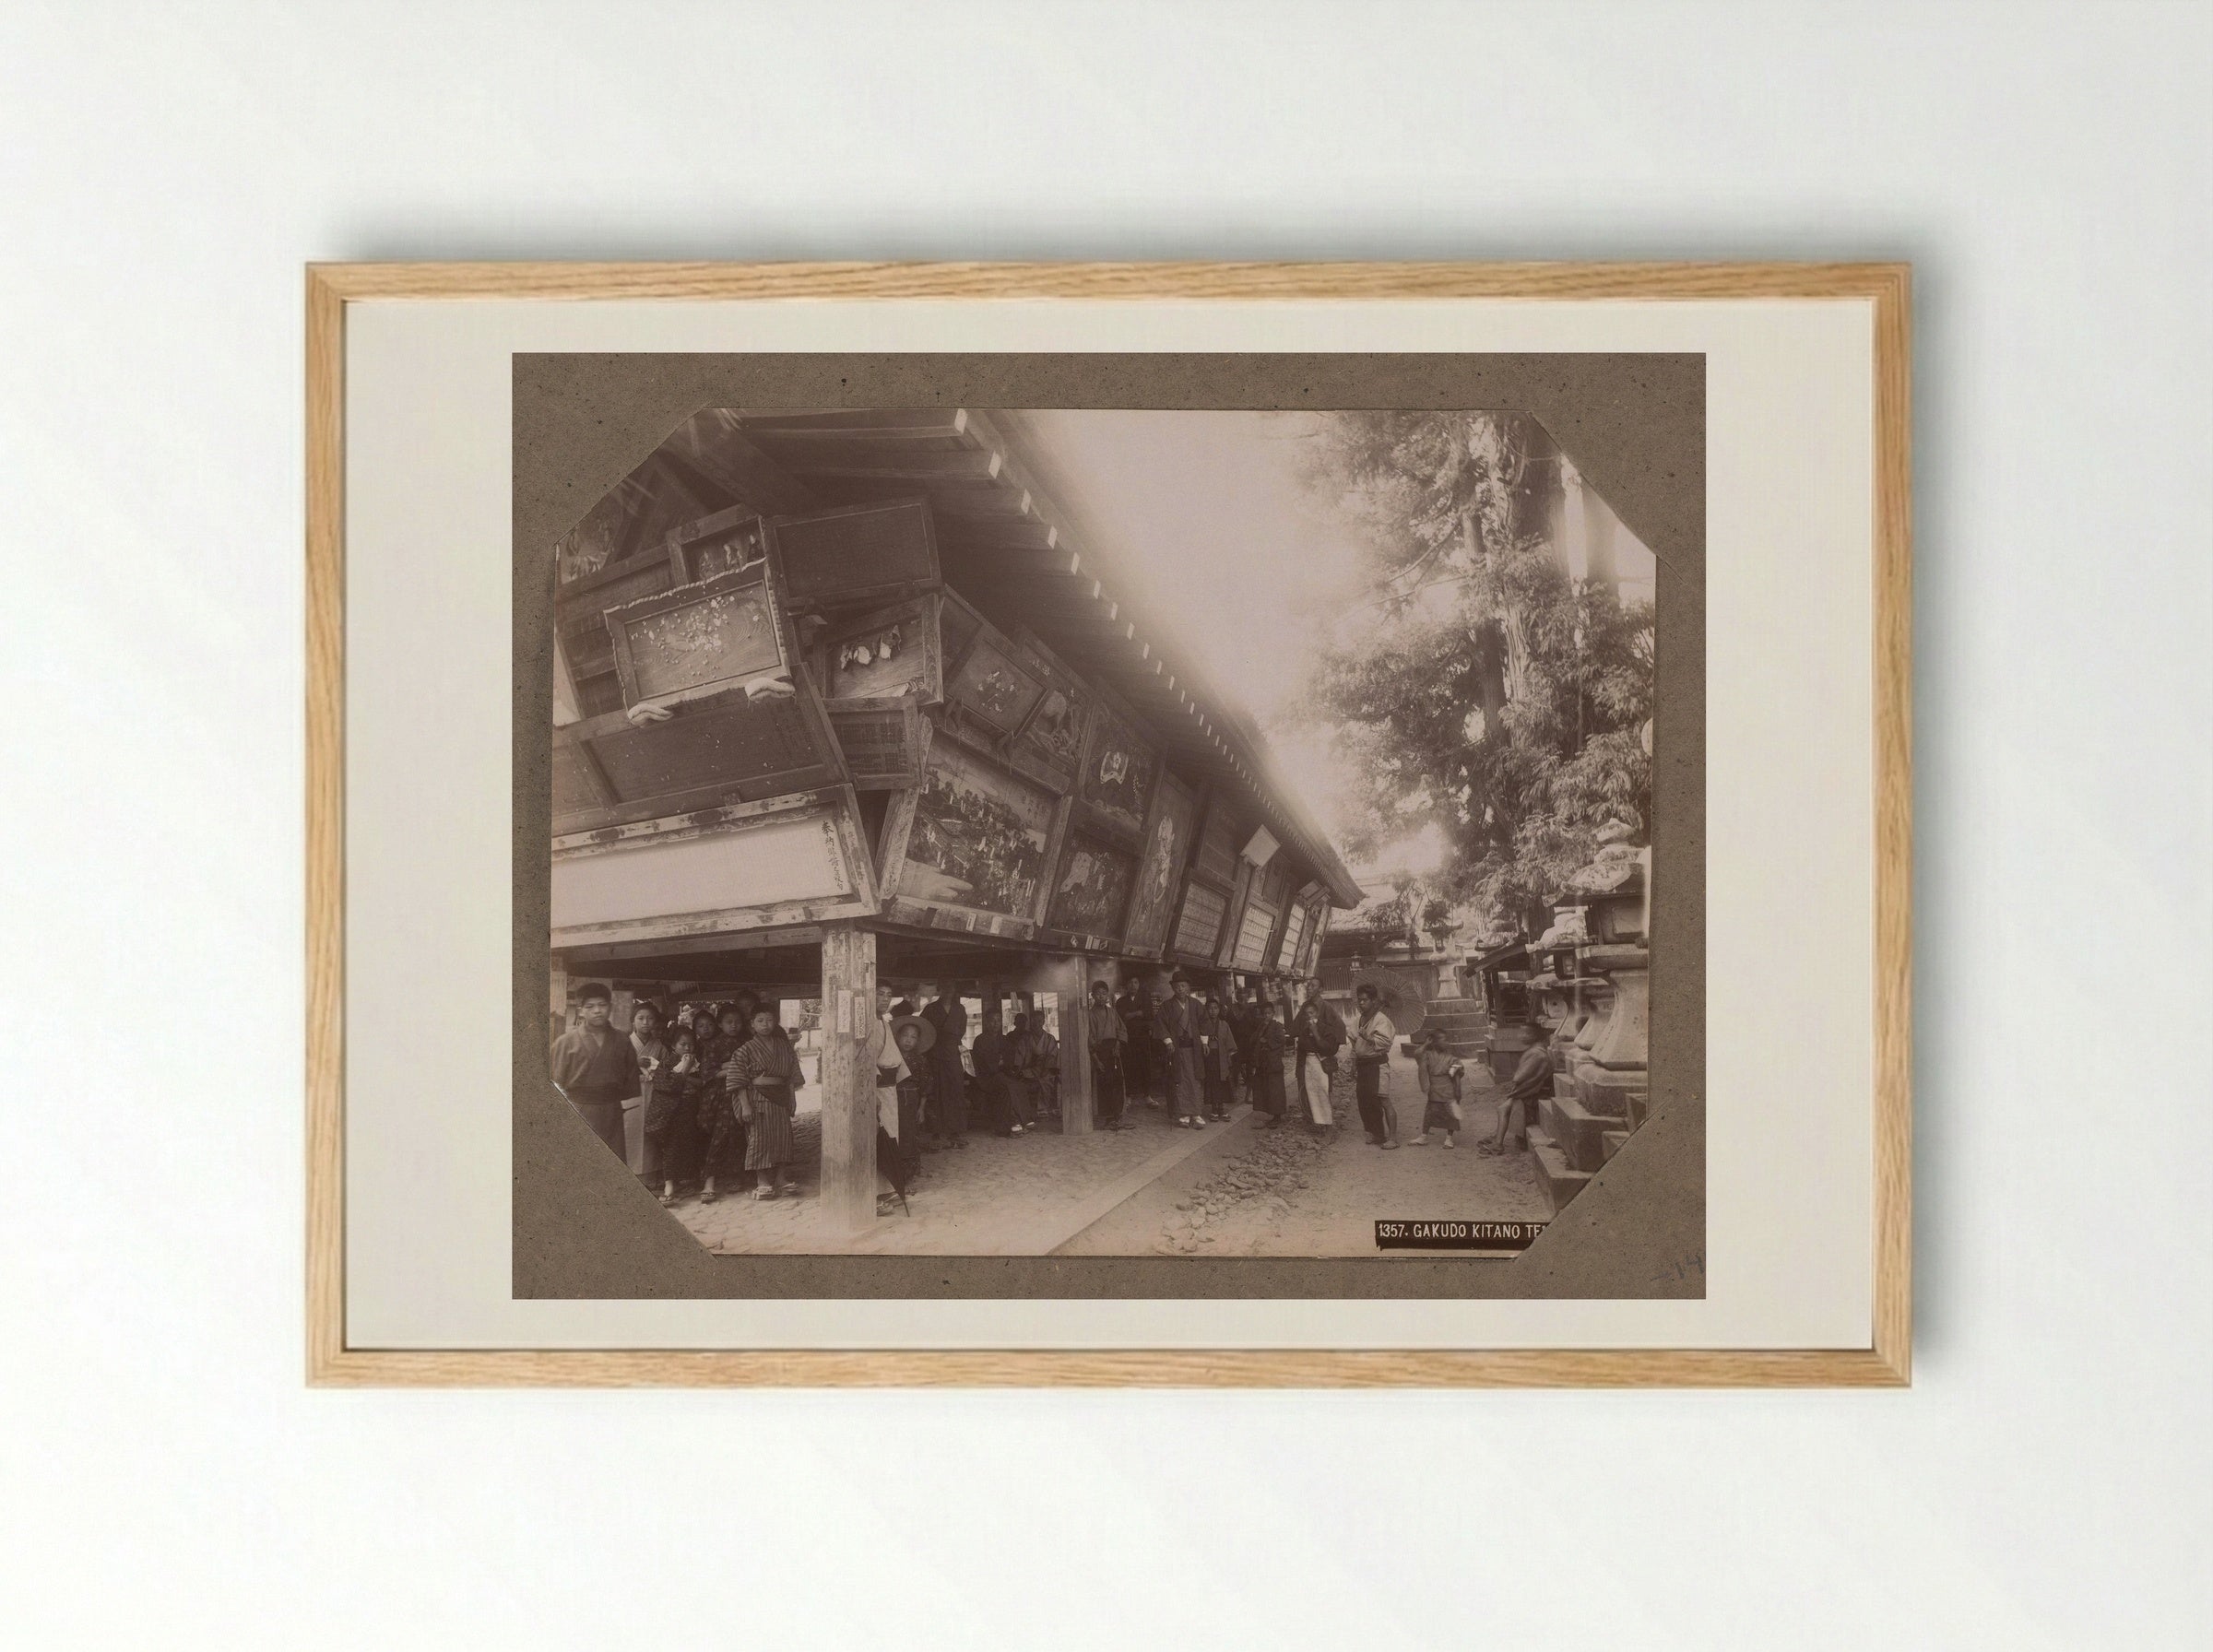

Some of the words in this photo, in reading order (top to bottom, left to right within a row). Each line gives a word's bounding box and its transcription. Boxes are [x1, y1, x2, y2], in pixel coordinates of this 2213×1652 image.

[1378, 1222, 1409, 1238] 1357.
[1413, 1222, 1467, 1238] GAKUDO
[1472, 1223, 1521, 1239] KITANO
[1524, 1224, 1545, 1239] TE
